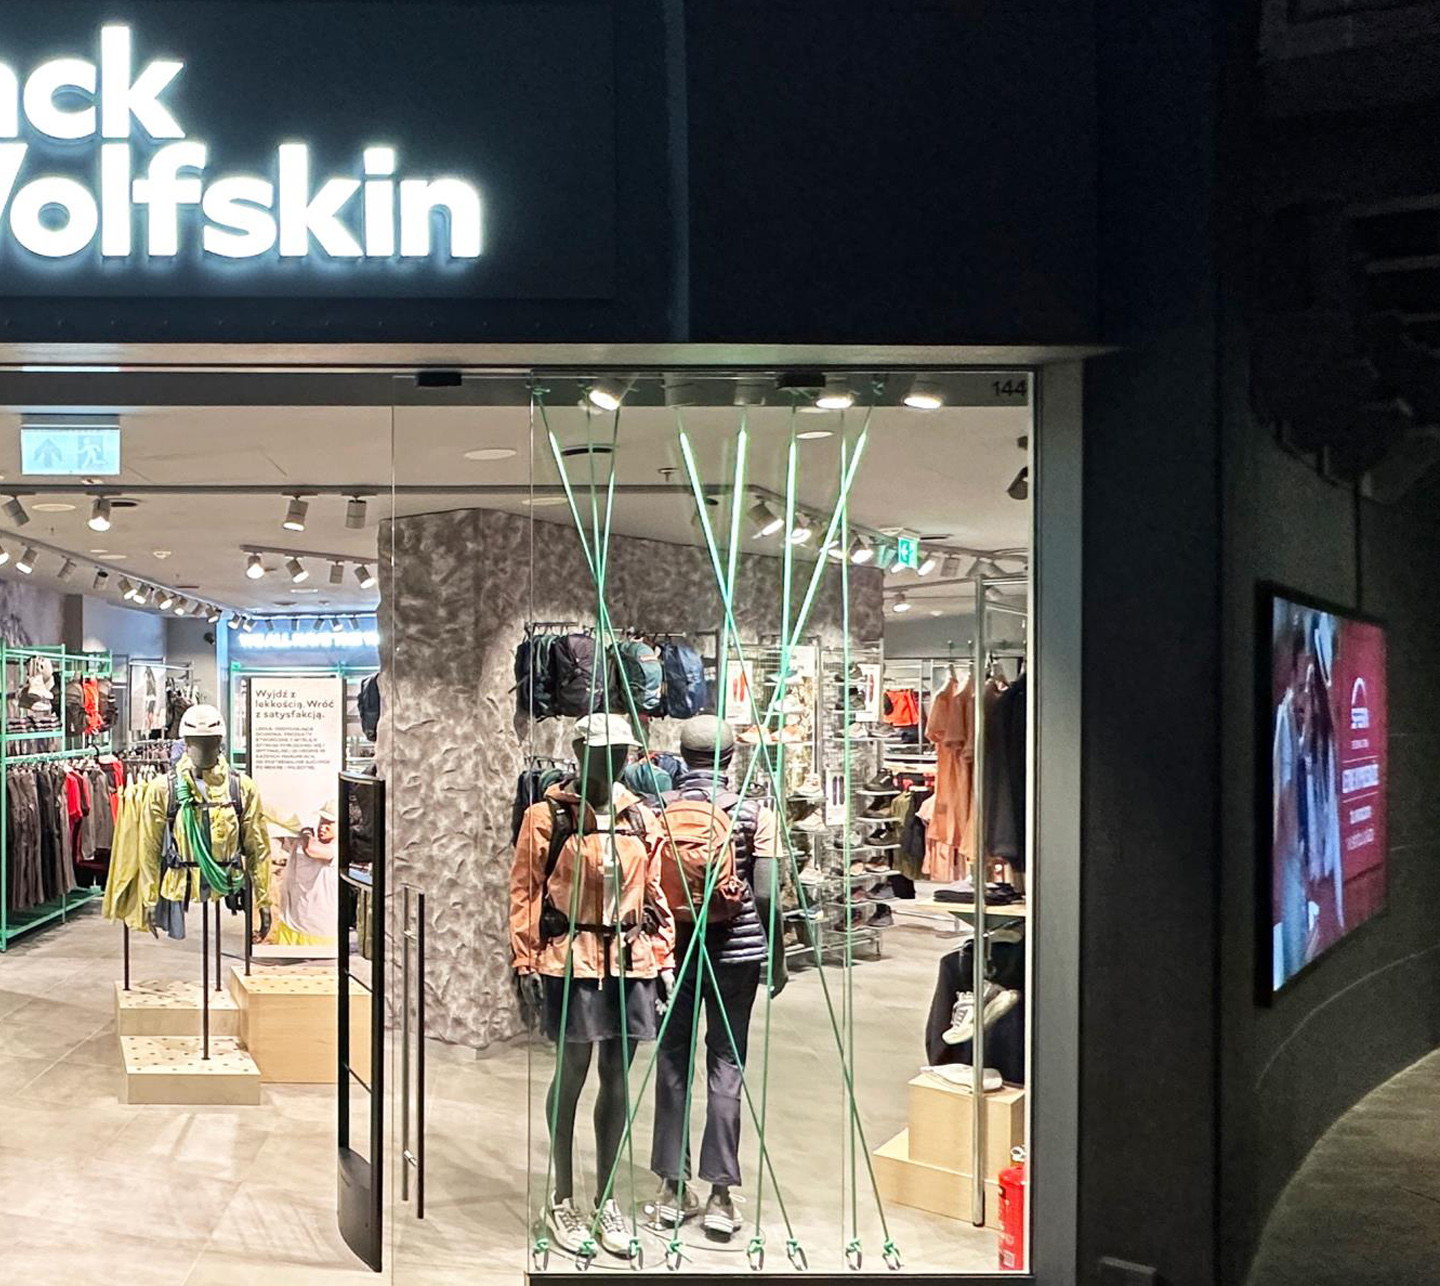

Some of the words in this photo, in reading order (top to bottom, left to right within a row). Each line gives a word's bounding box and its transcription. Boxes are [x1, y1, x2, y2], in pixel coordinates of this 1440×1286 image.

[992, 380, 1027, 397] 144
[255, 689, 288, 700] Wyjdź
[306, 700, 334, 708] Wróć
[264, 710, 325, 720] satysfakcją.
